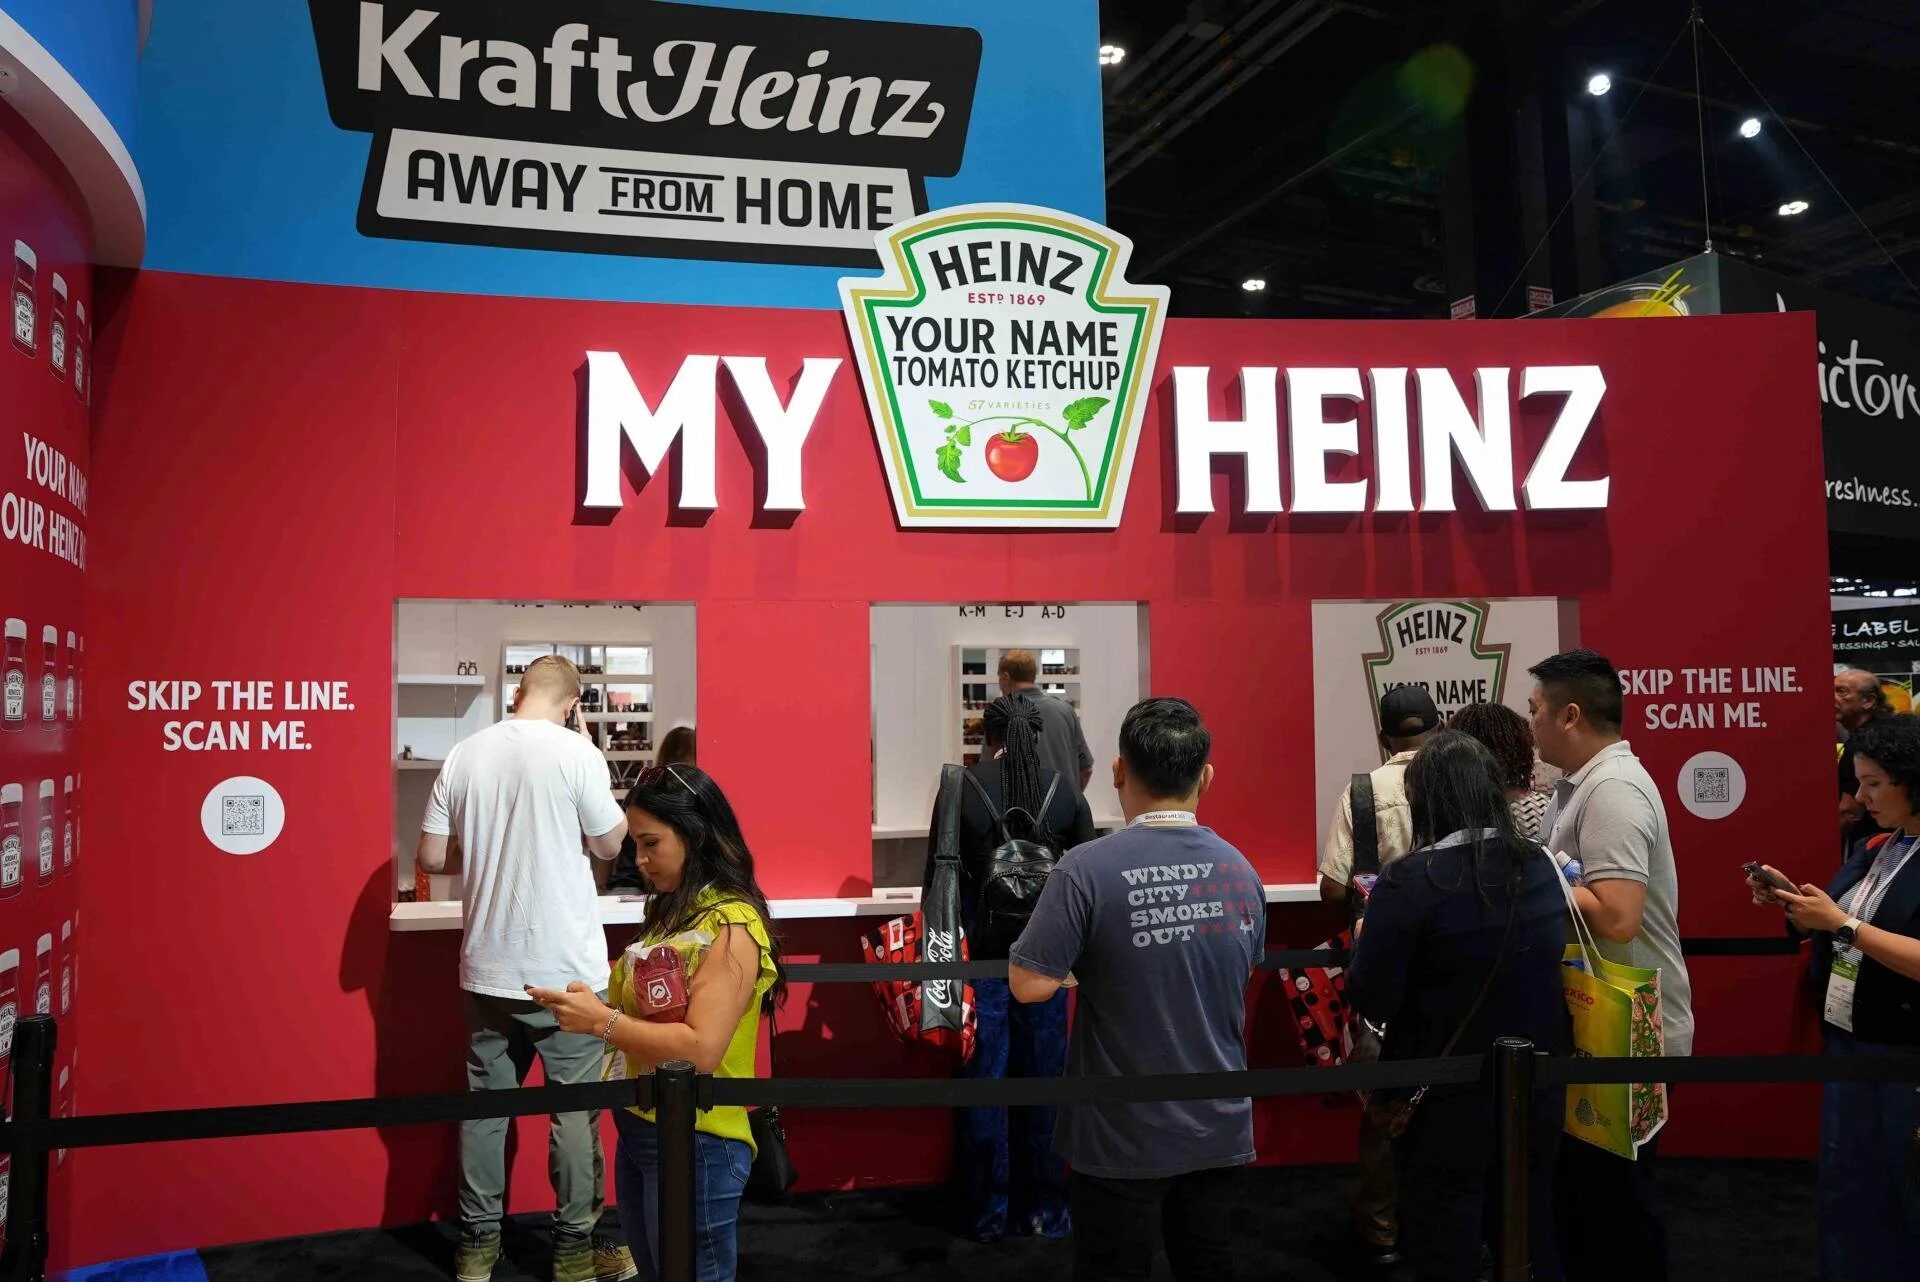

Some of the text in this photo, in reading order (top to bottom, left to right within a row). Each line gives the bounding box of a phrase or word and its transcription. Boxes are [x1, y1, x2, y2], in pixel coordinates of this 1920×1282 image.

[407, 149, 894, 231] AWAY FROM HOME
[928, 241, 1083, 295] HEINZ
[1010, 294, 1045, 306] 1869
[886, 315, 1119, 357] YOUR NAME
[893, 356, 1120, 390] TOMATO KETCHUP
[968, 400, 1051, 411] 57 VARIETIES
[584, 351, 1610, 514] MY HEINZ
[23, 432, 66, 498] YOUR
[1, 492, 44, 550] OUR
[49, 510, 79, 566] HEINZ
[959, 605, 1065, 618] K-M E-J A-D
[1396, 610, 1467, 648] HEINZ
[1843, 620, 1919, 637] LABEL
[1432, 646, 1448, 655] 1869
[1436, 678, 1487, 704] NAME
[1617, 666, 1803, 696] SKIP THE LINE.
[128, 680, 355, 711] SKIP THE LINE.
[1645, 702, 1767, 729] SCAN ME.
[163, 721, 312, 751] SCAN ME.
[1121, 862, 1214, 886] WINDY
[1127, 884, 1189, 907] CITY
[1130, 901, 1224, 928] SMOKE
[1132, 925, 1195, 948] OUT
